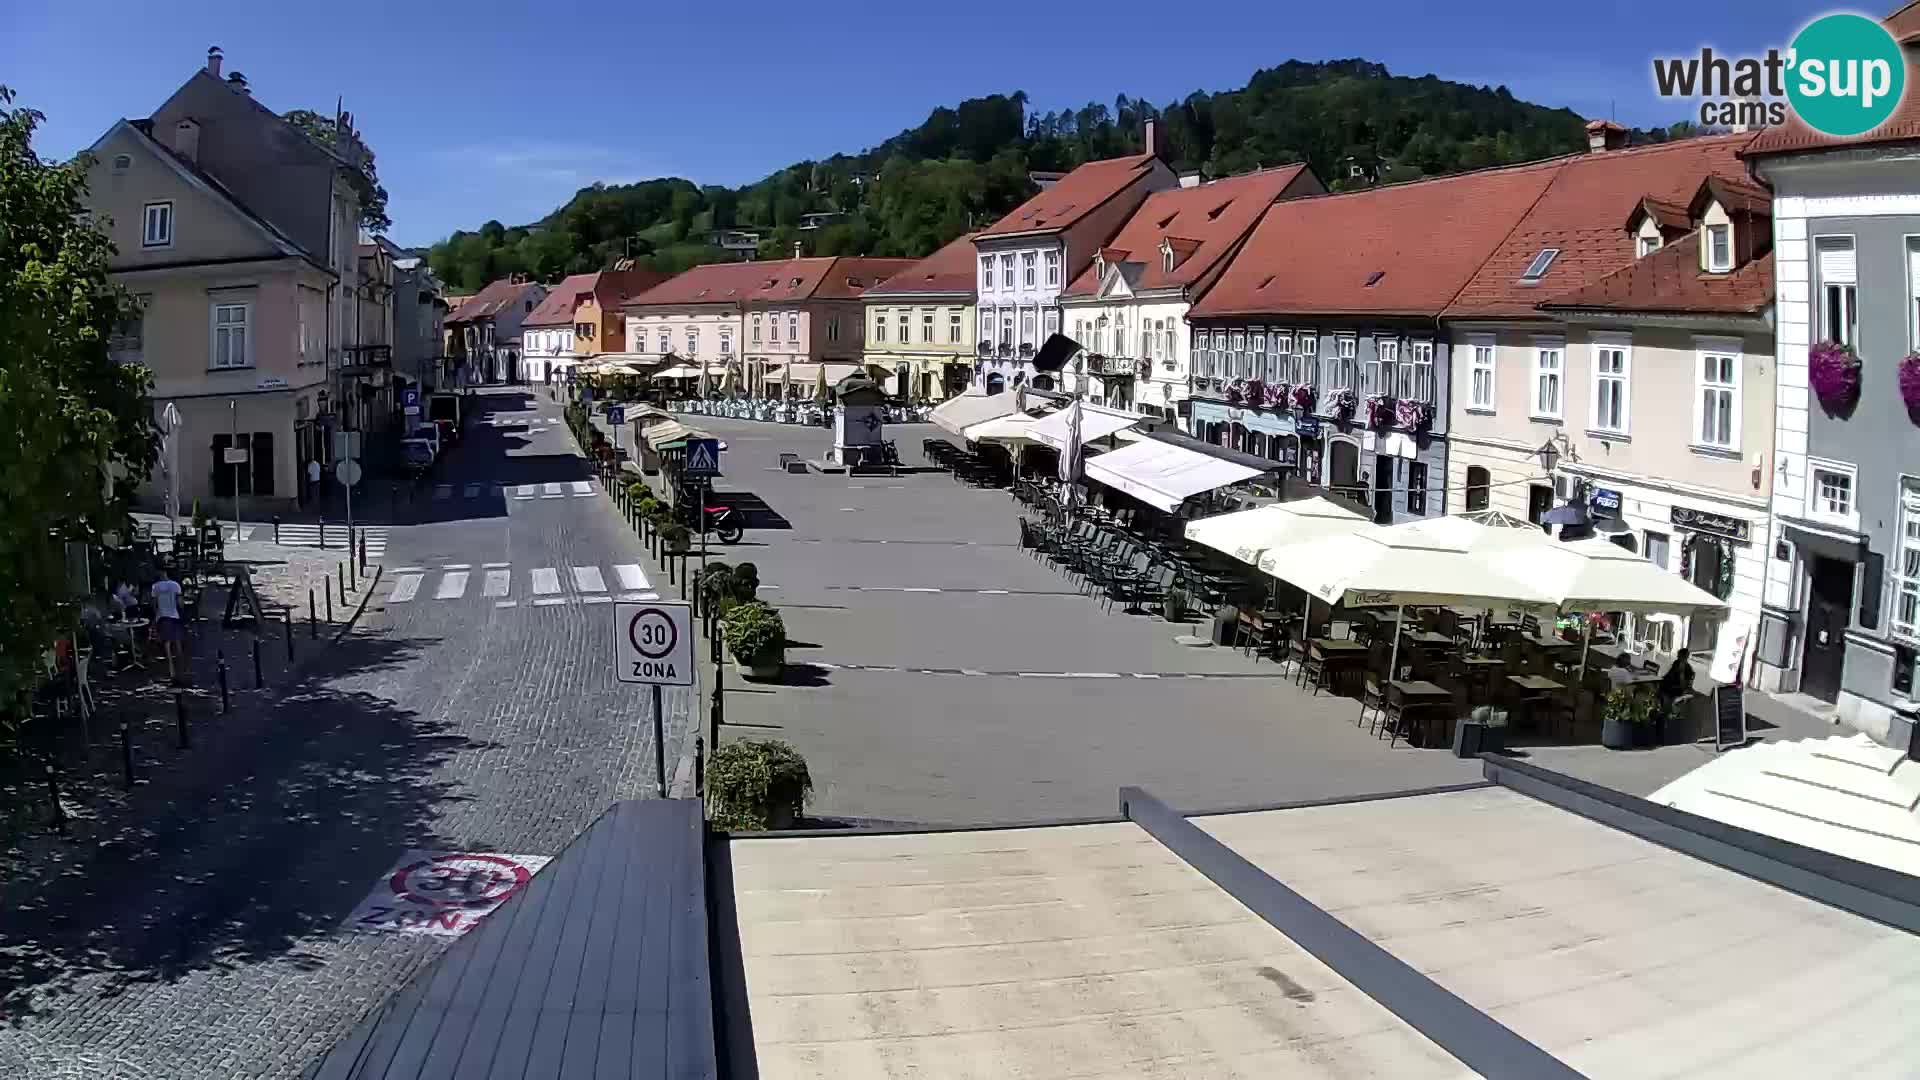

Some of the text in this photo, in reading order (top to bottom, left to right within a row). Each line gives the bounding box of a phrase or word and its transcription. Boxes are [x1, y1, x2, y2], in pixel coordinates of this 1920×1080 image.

[407, 392, 415, 404] P
[642, 624, 666, 645] 30
[632, 661, 677, 678] ZONA
